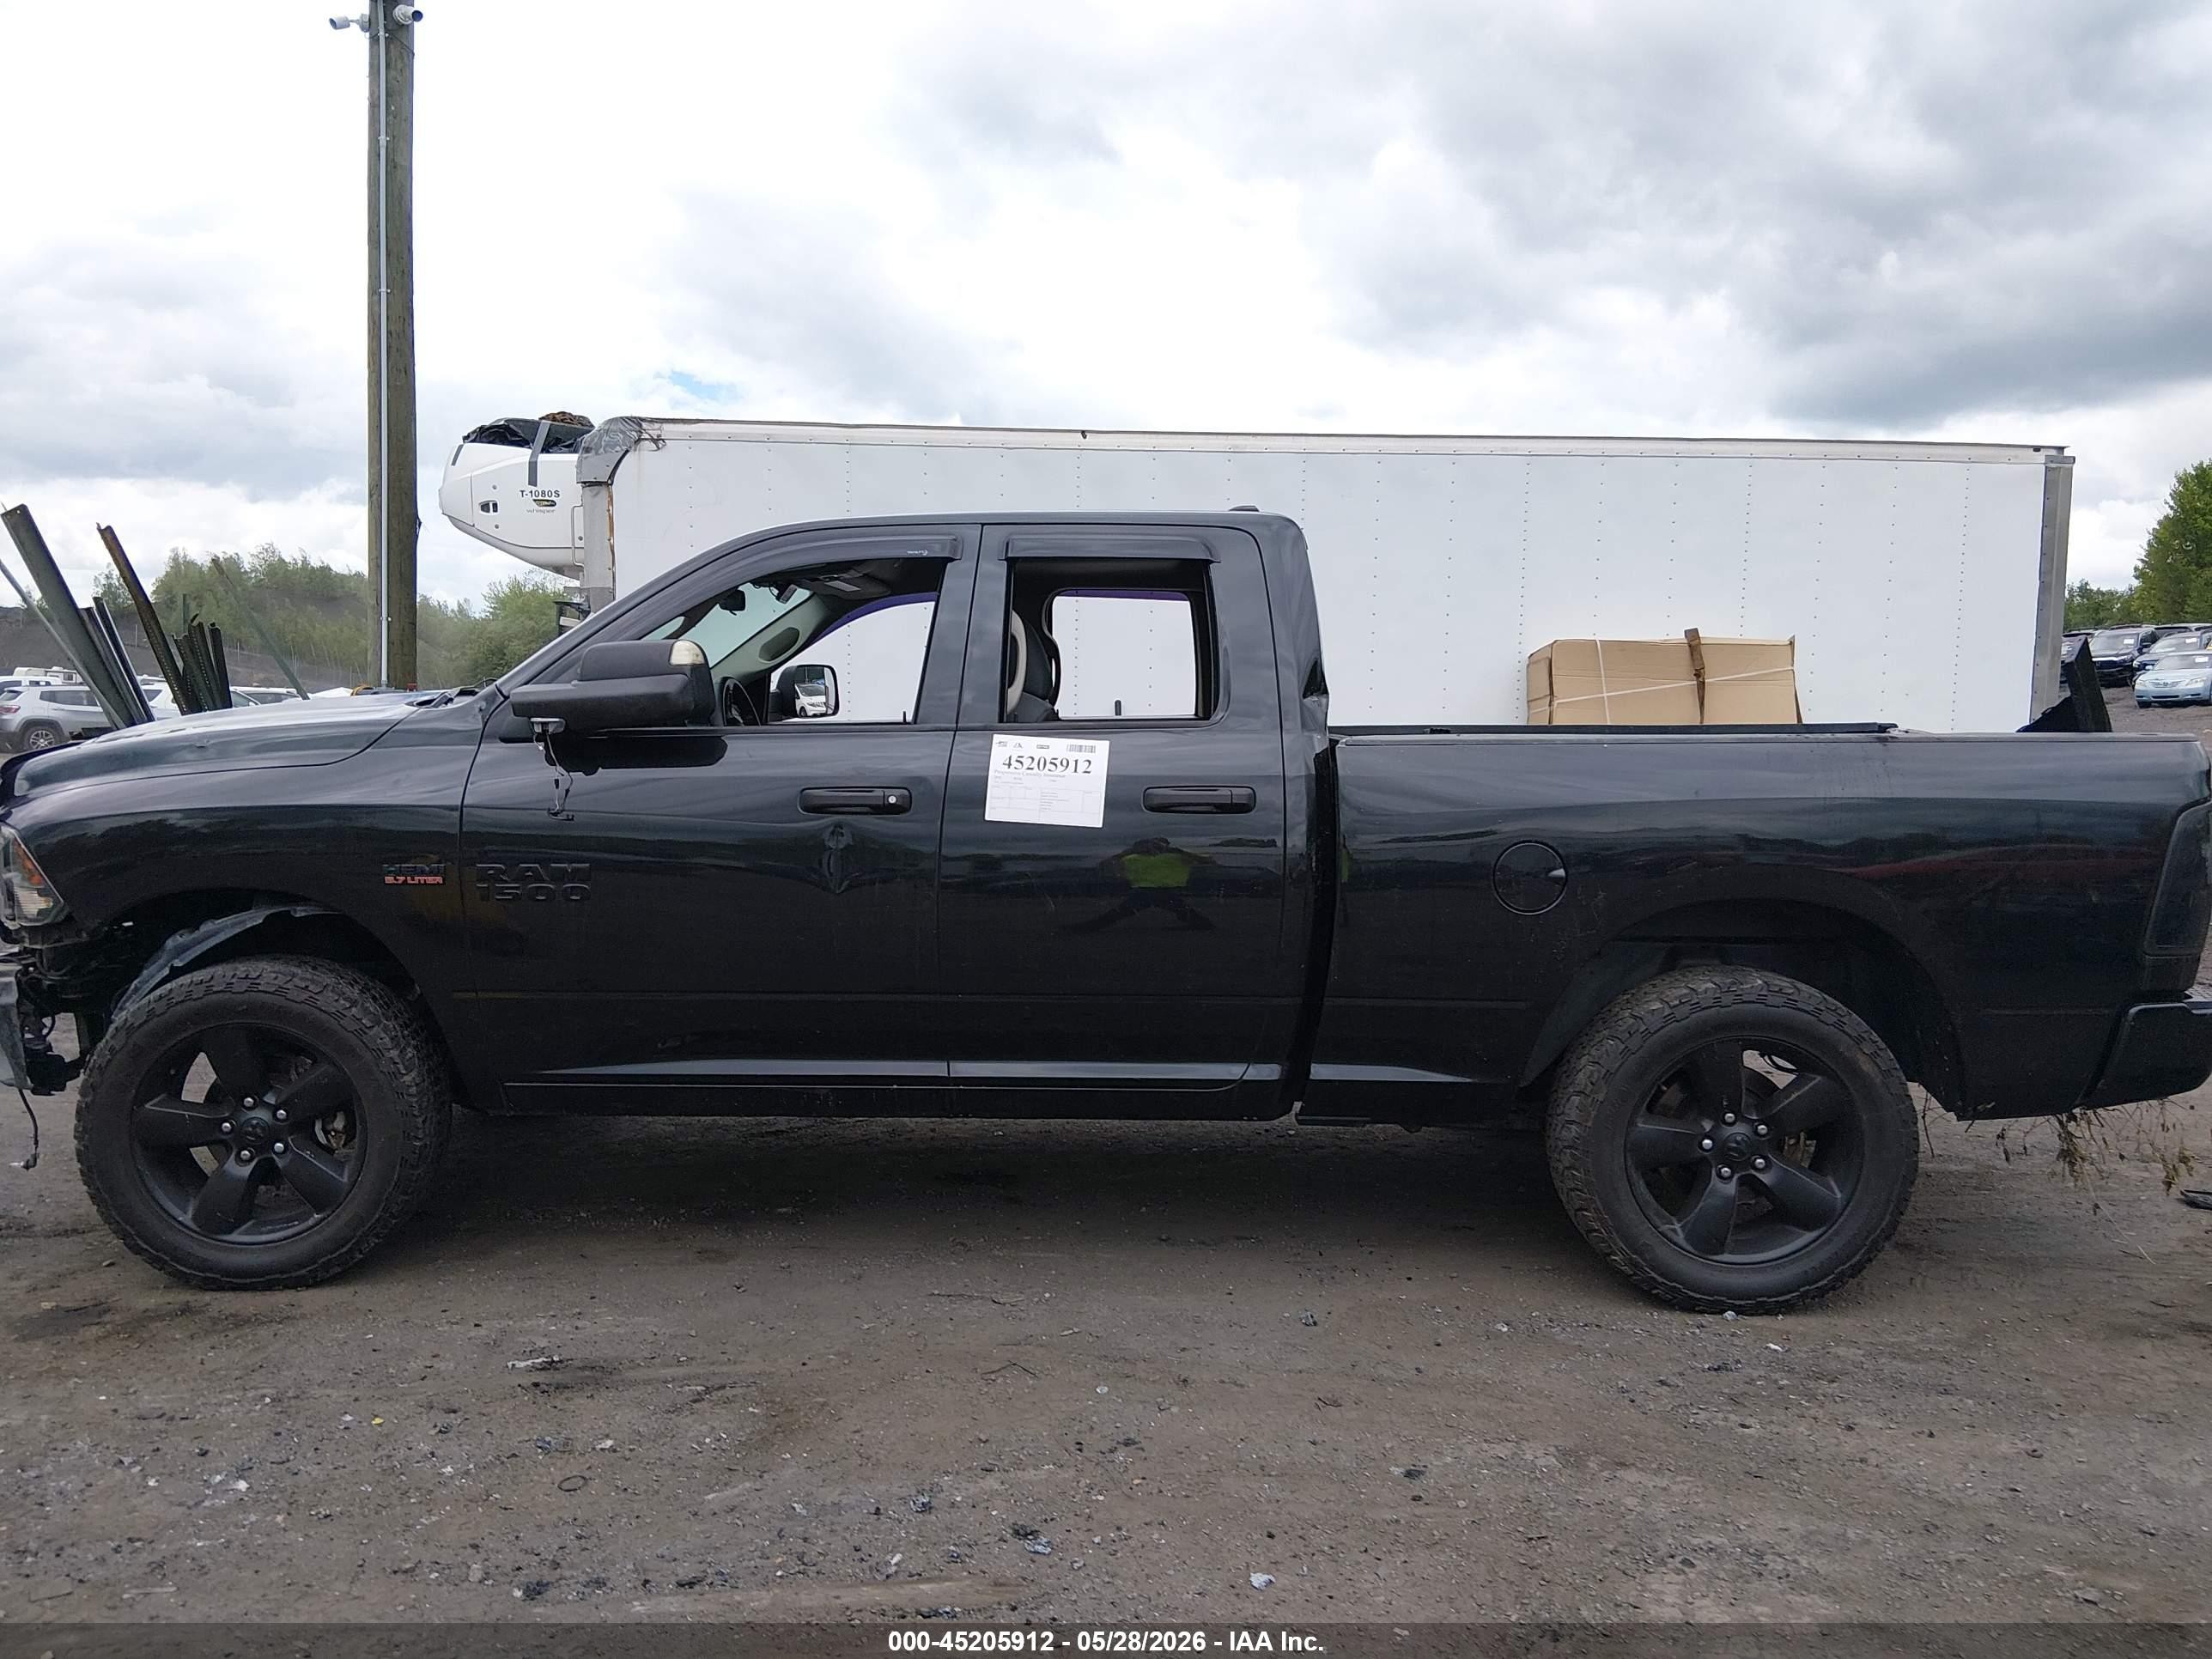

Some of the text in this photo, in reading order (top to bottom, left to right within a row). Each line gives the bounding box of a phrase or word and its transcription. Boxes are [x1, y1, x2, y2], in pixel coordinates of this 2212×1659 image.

[520, 489, 560, 498] T-1080S
[1002, 755, 1091, 774] 45205912
[383, 864, 445, 875] HEMI
[476, 863, 592, 881] RAM
[406, 876, 443, 884] LITER
[476, 884, 592, 901] 1500
